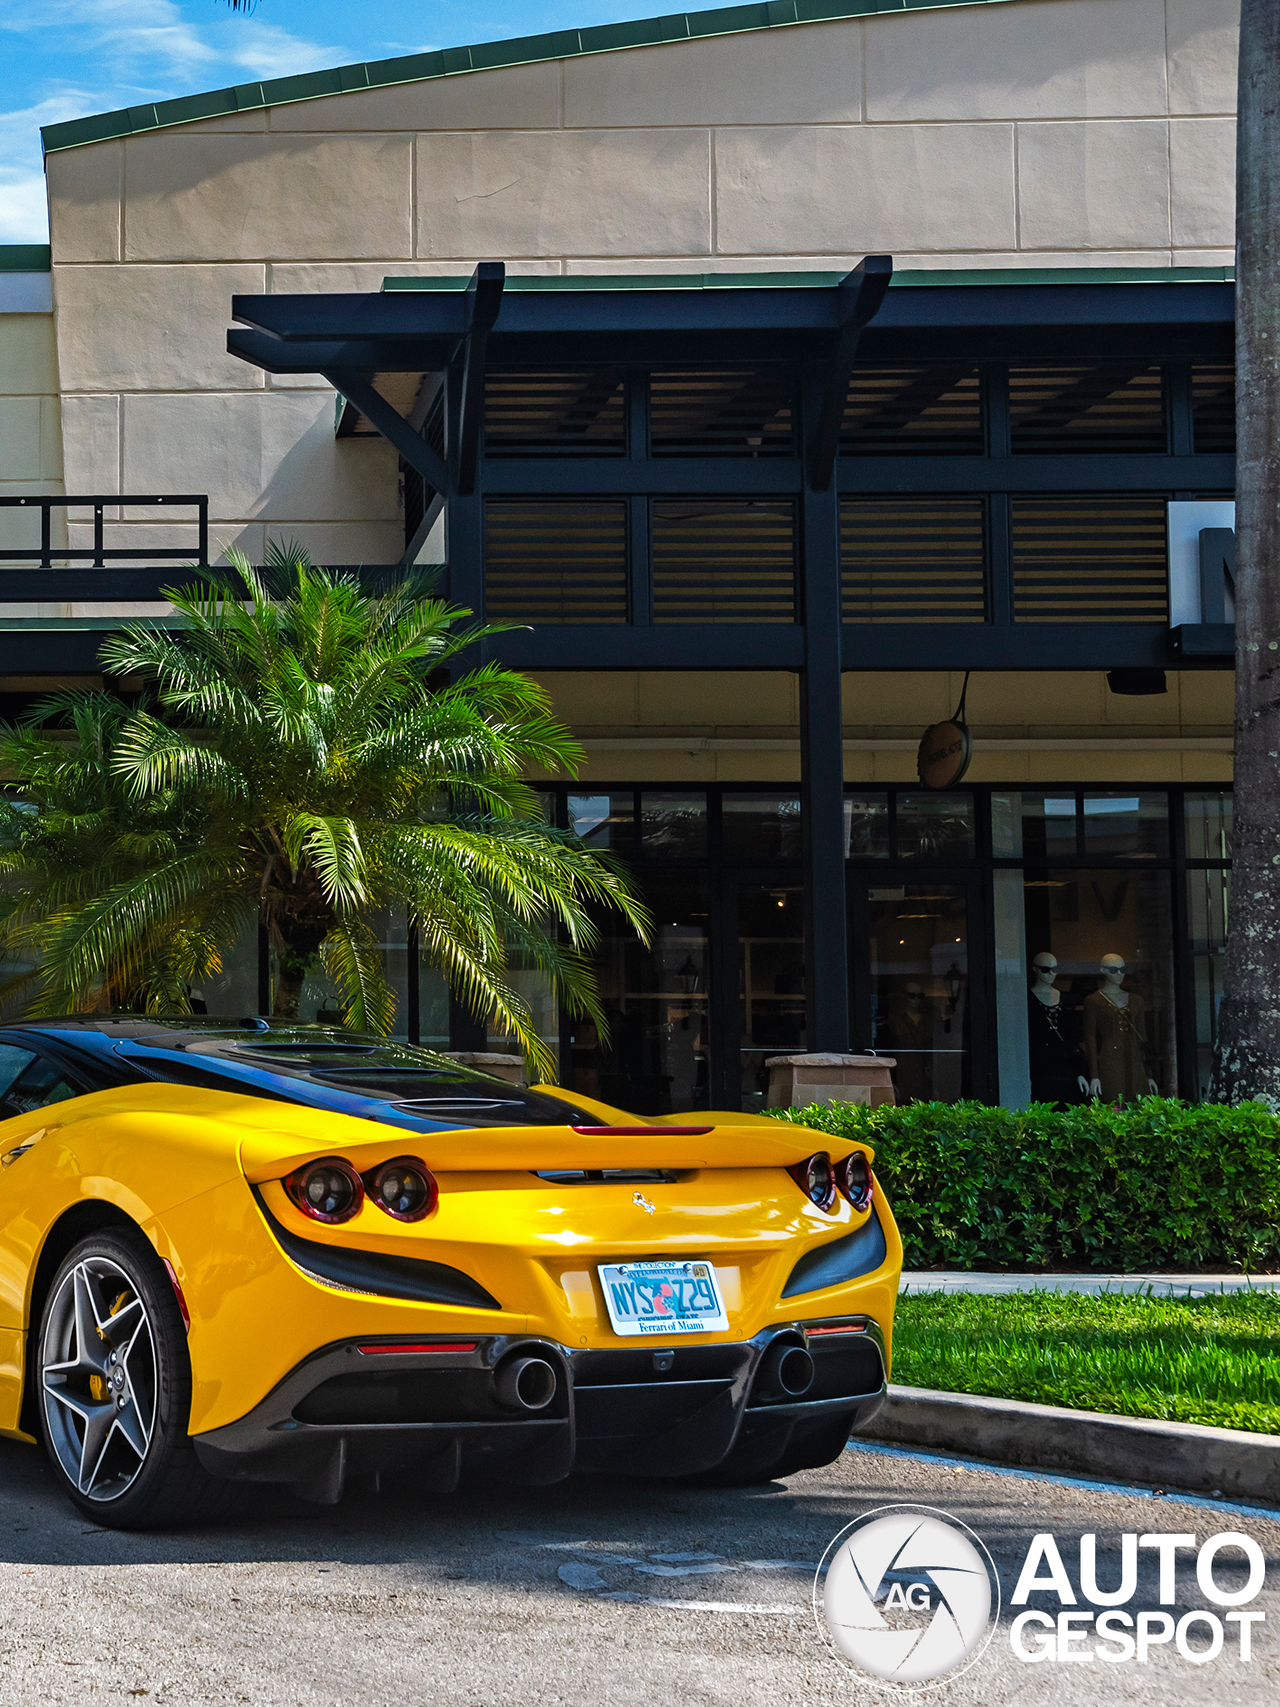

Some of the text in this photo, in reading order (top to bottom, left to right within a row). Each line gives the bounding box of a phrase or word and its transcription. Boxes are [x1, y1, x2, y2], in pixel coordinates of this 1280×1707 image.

[638, 1320, 705, 1333] Ferrari of Miami
